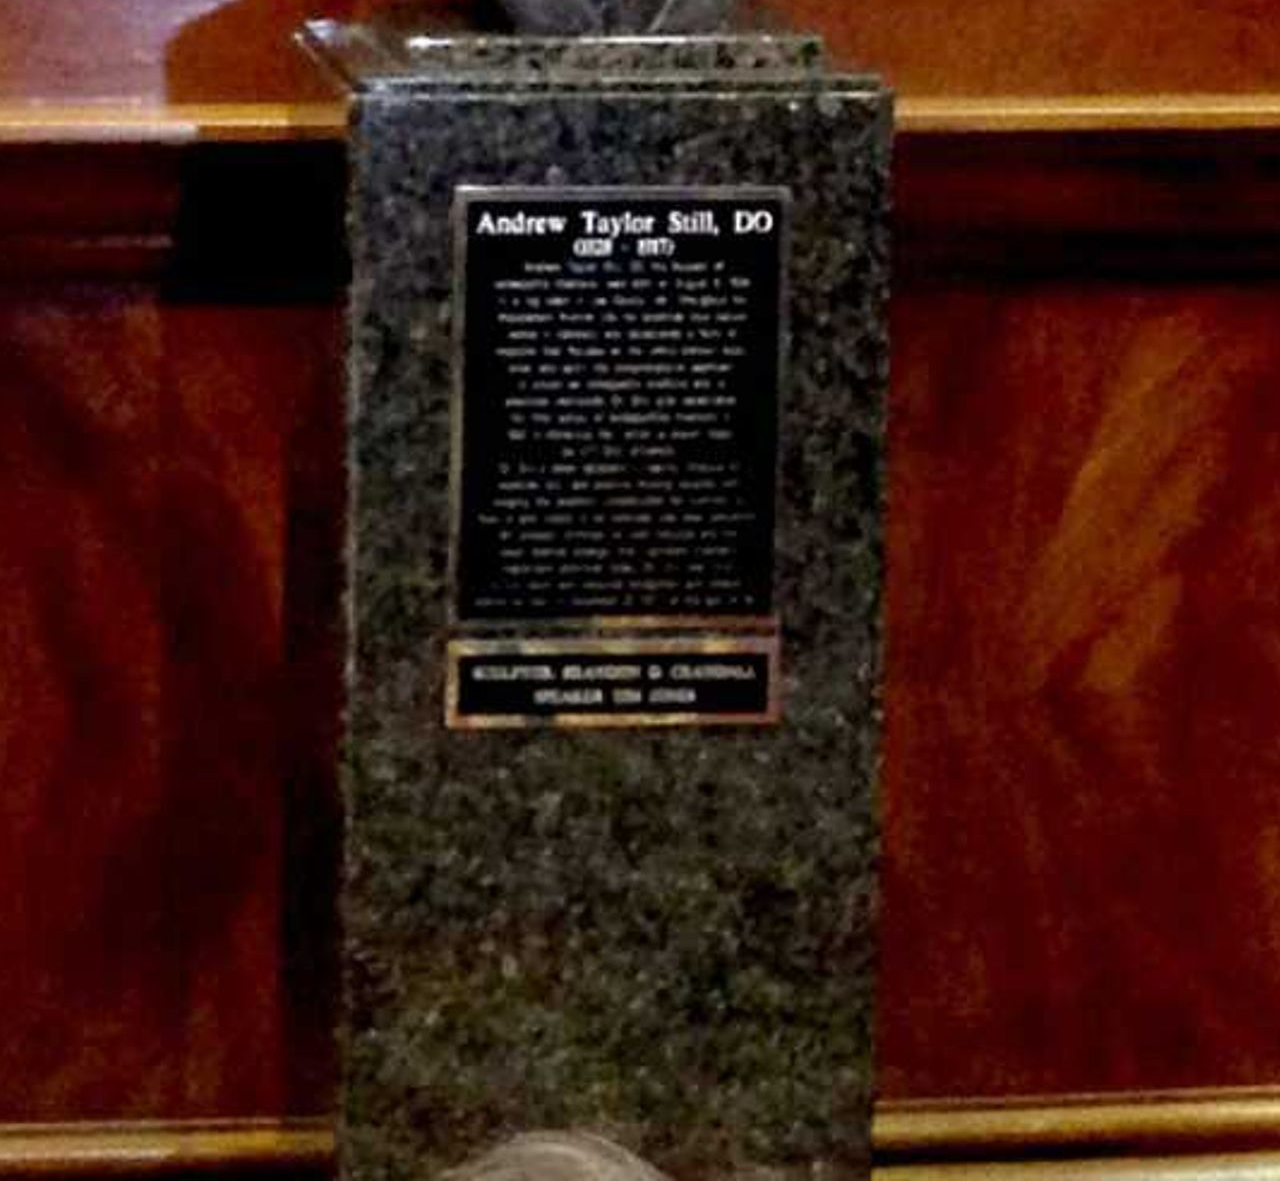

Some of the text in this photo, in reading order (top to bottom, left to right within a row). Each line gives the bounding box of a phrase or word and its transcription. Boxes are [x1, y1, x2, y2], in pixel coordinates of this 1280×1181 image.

[475, 210, 774, 238] Andrew Taylor Still, DO
